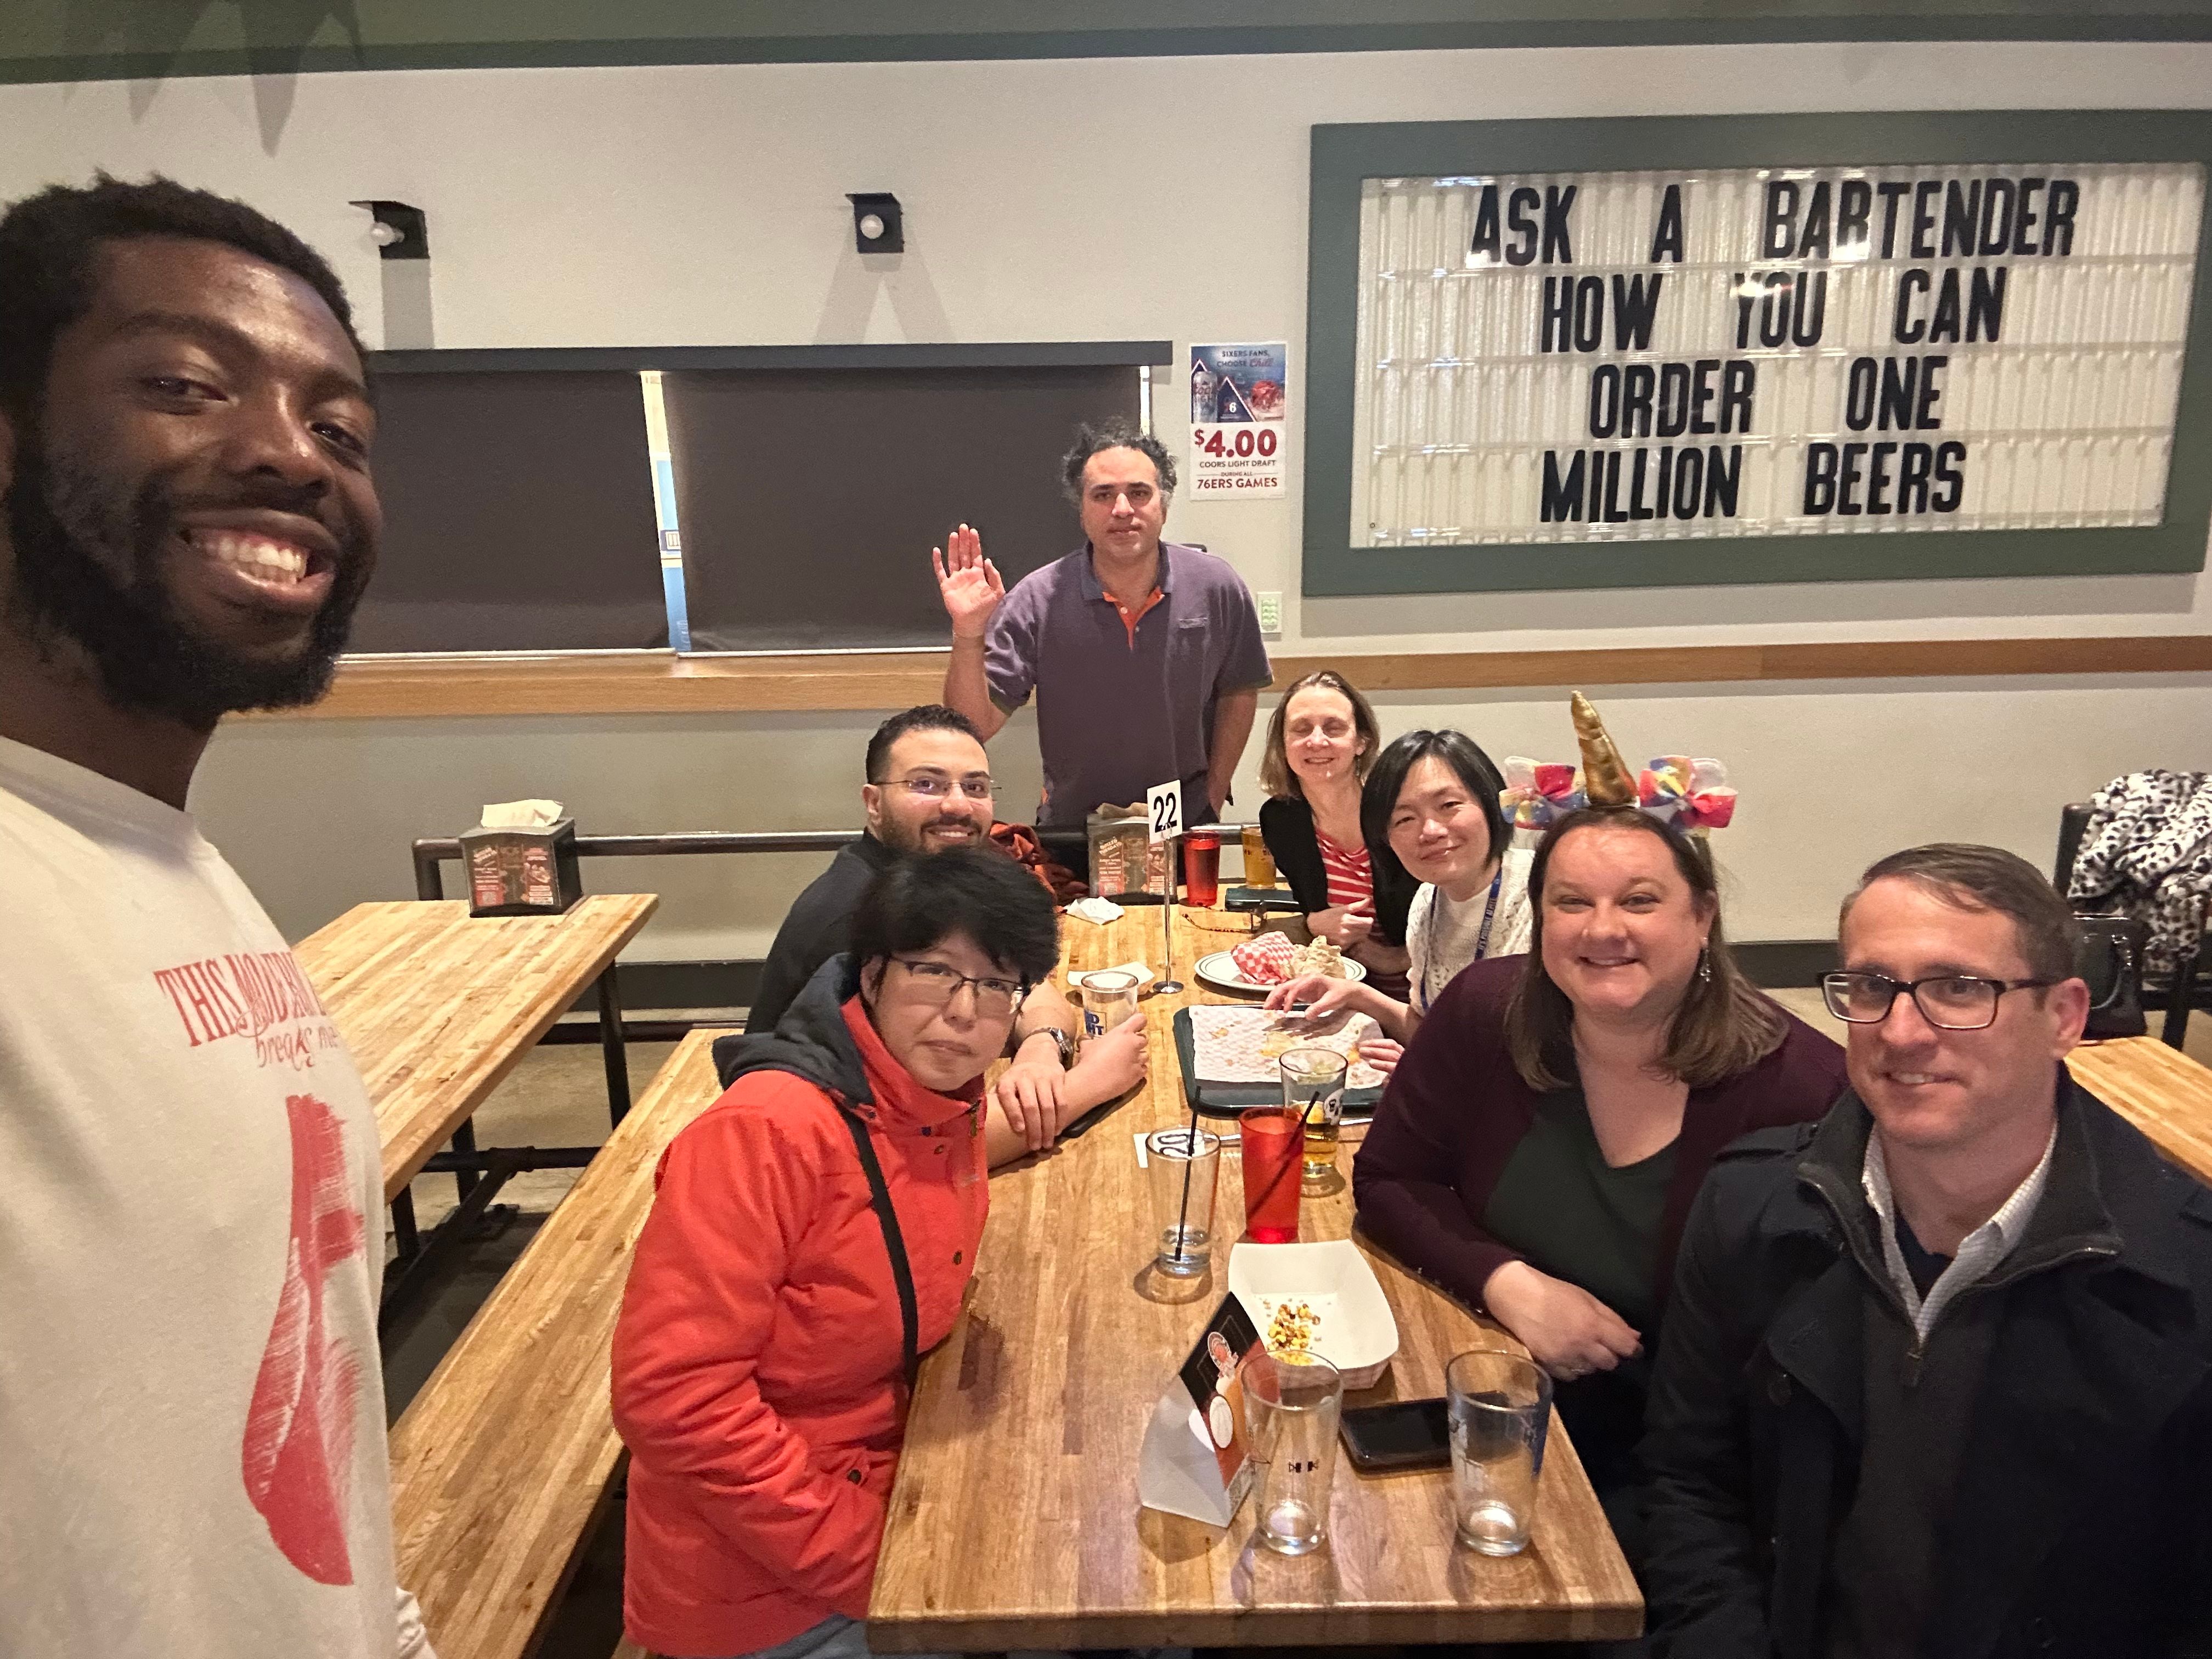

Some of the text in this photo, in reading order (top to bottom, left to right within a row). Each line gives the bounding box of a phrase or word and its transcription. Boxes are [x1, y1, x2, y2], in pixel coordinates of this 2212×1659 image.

[1471, 178, 2080, 266] ASK A BARTENDER
[1542, 267, 2007, 353] HOW YOU CAN
[1589, 355, 1948, 439] ORDER ONE
[1194, 428, 1277, 458] $4.00
[1197, 477, 1277, 489] 76ERS GAMES
[1541, 440, 1967, 523] MILLION BEERS
[1153, 792, 1177, 833] 22
[154, 958, 247, 1047] THIS
